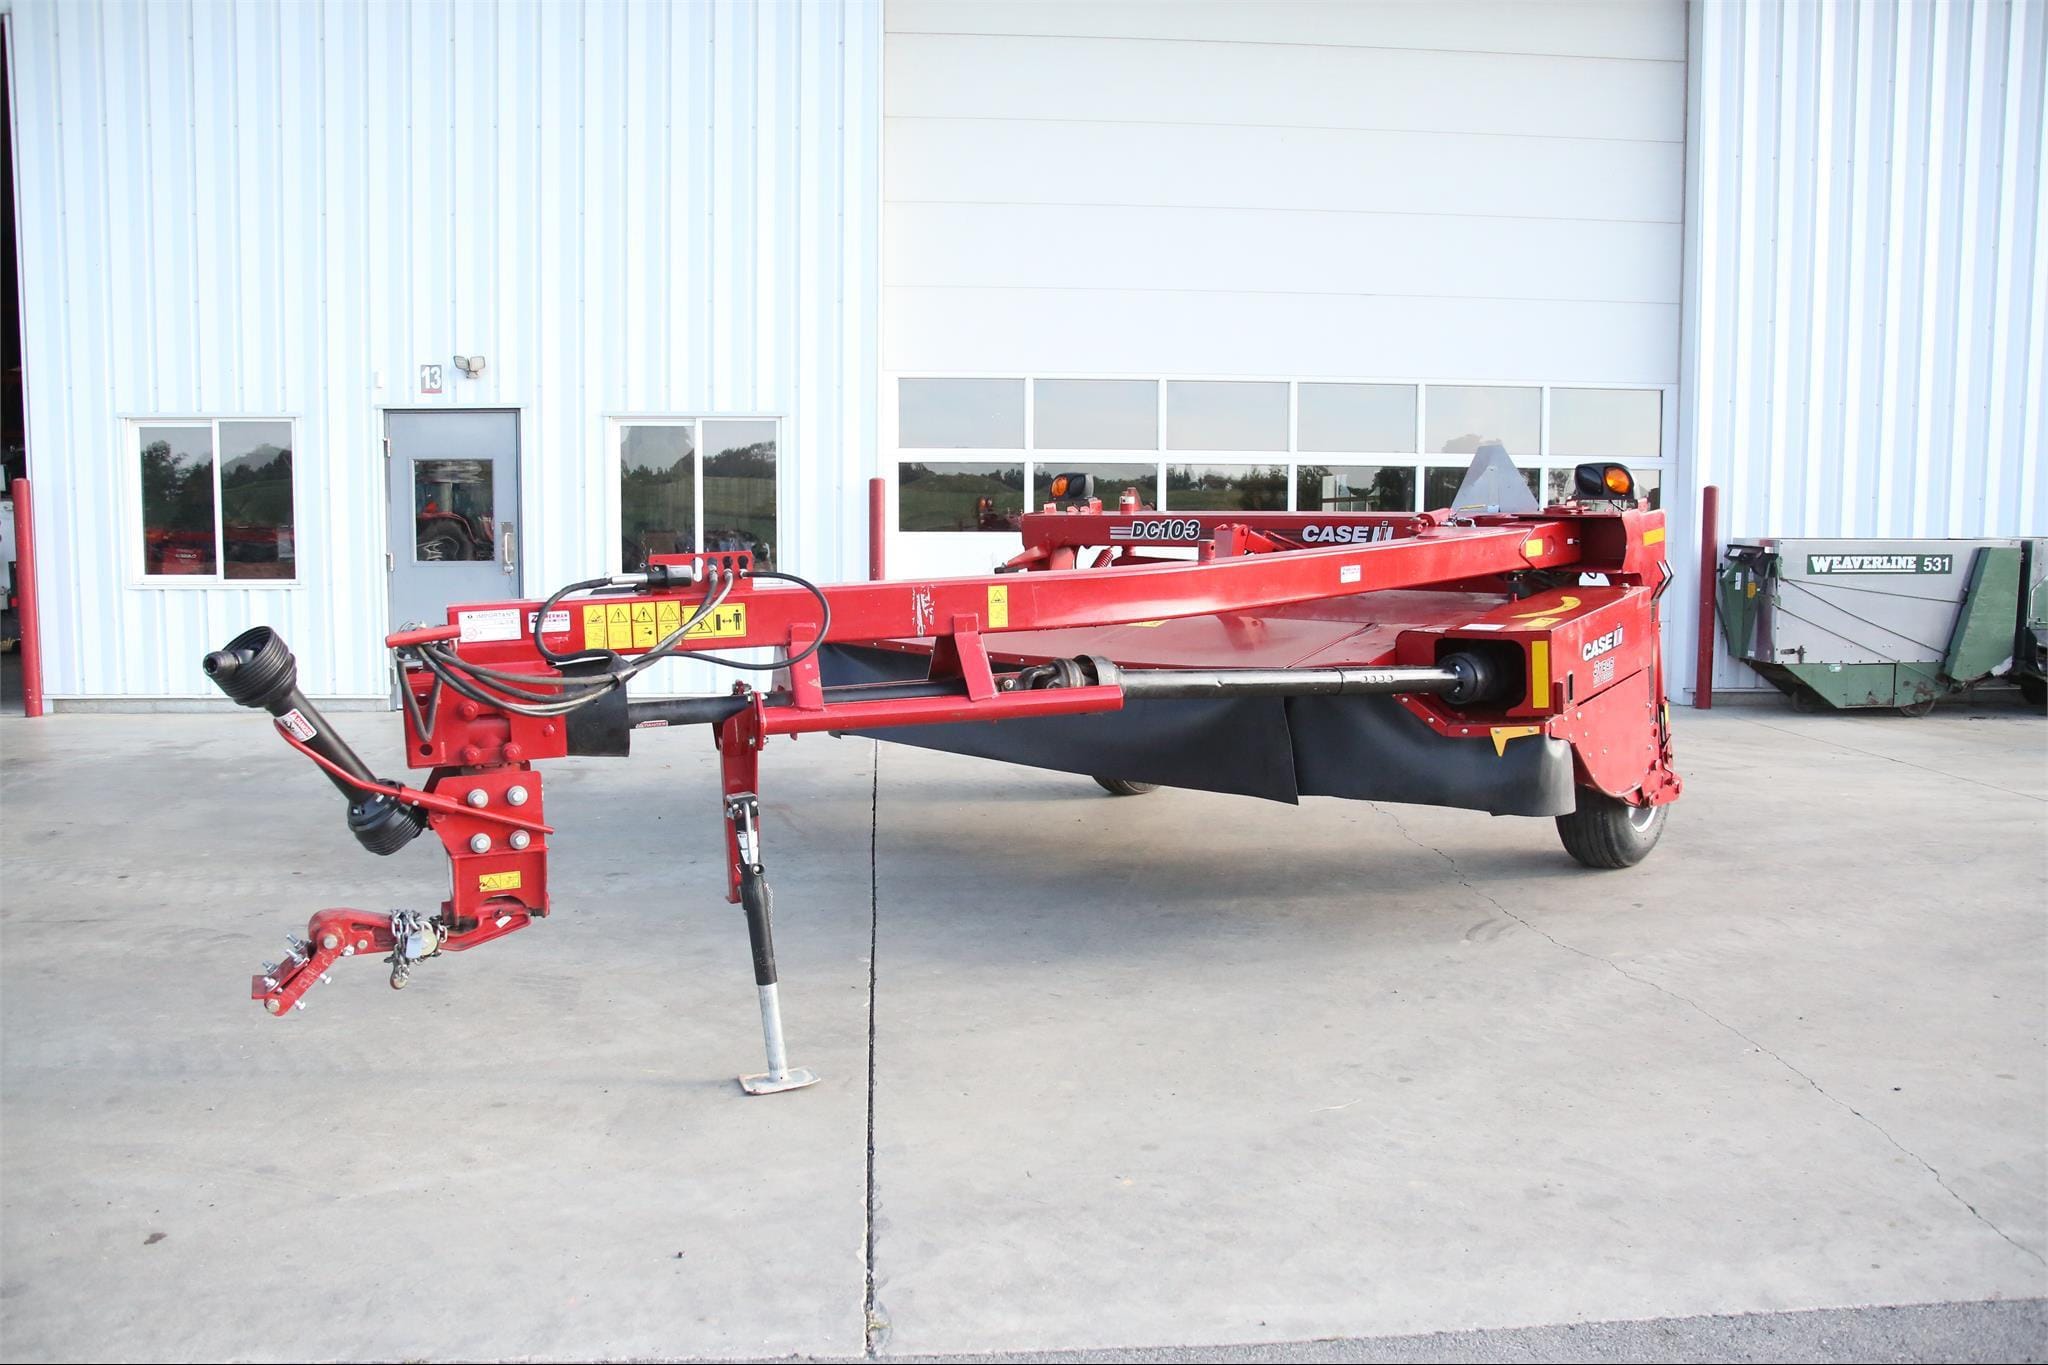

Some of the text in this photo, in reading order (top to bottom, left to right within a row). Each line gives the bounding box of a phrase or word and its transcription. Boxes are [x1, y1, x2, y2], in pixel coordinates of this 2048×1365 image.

[422, 366, 441, 389] 13
[1131, 520, 1200, 541] DC103
[1302, 525, 1370, 543] CASE
[1811, 556, 1950, 573] WEAVERLINE 531
[1583, 631, 1614, 661] CASE
